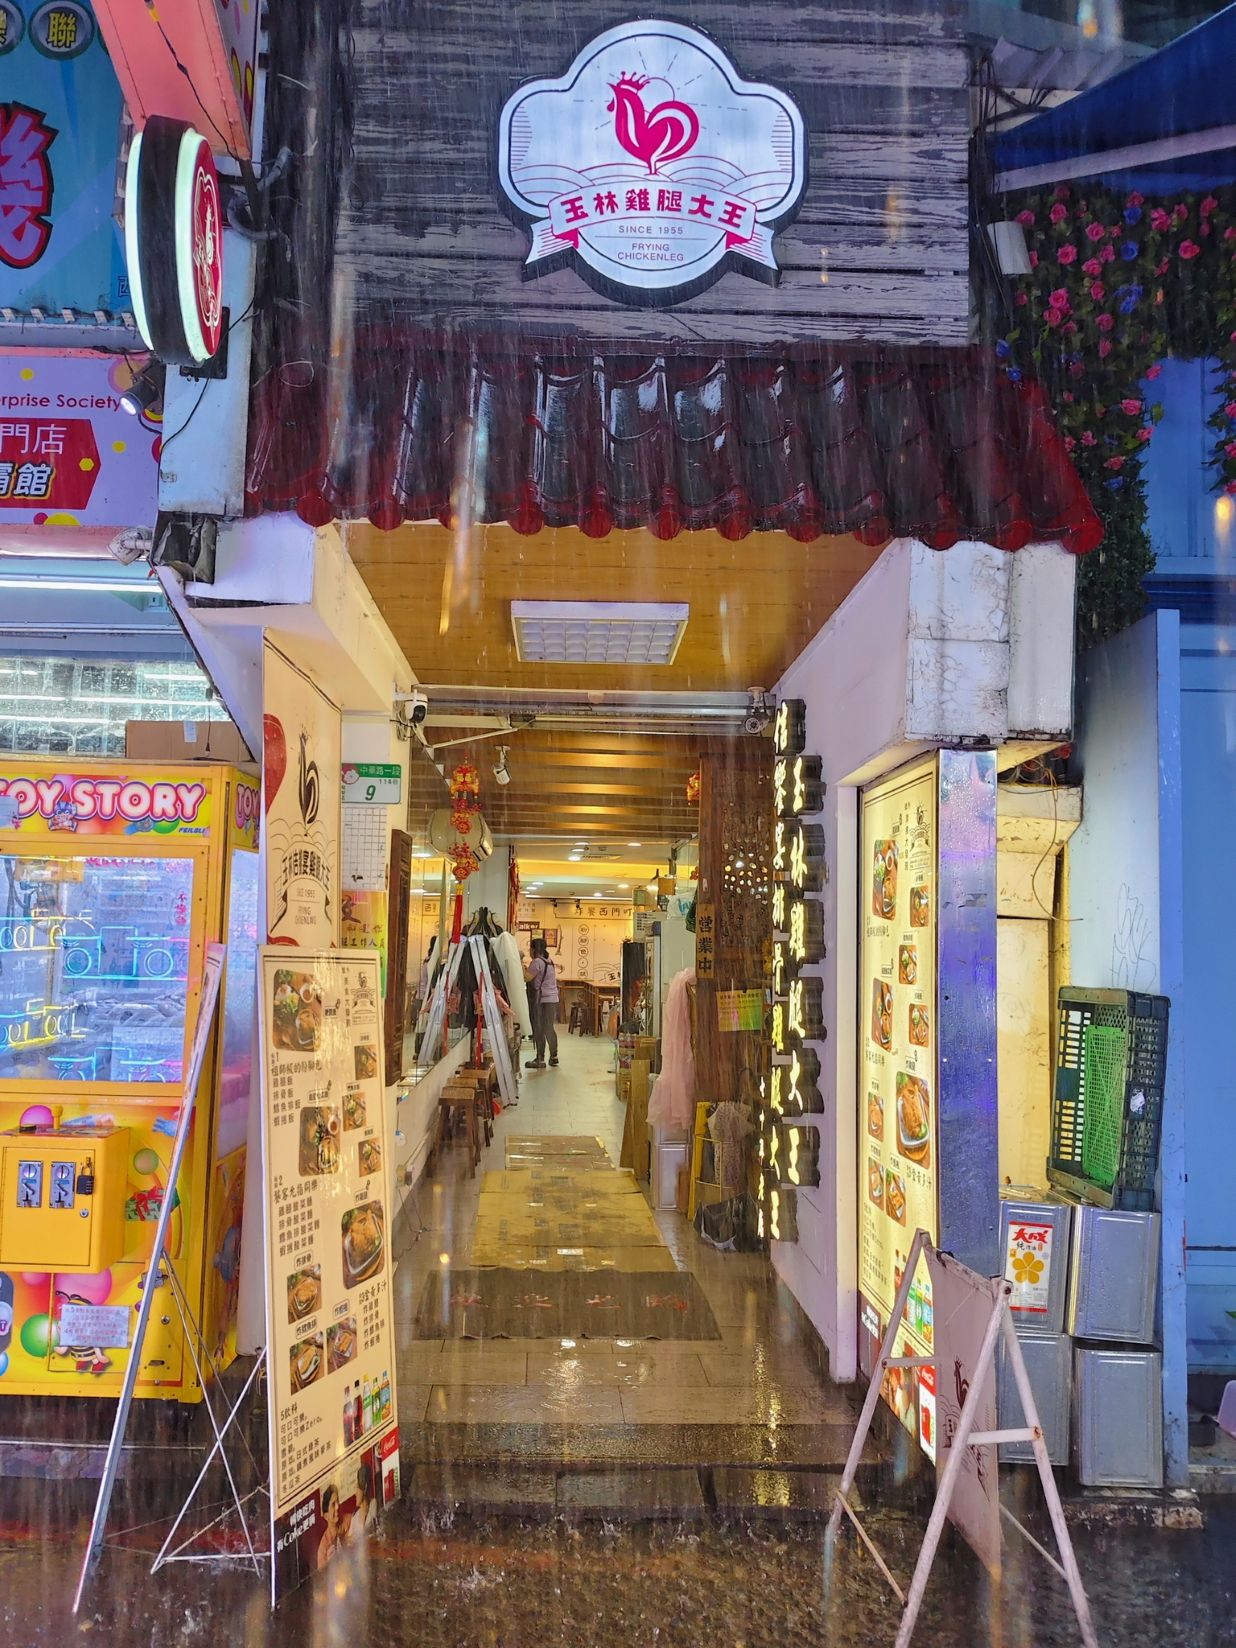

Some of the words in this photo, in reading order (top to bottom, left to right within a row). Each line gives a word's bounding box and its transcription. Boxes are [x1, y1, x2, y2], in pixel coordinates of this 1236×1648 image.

[47, 12, 77, 47] 聯
[560, 188, 747, 229] 玉林雞腿大王
[618, 225, 652, 234] SINCE
[658, 226, 684, 235] 1955
[631, 242, 670, 251] FRYING
[617, 251, 684, 262] CHICKENLEG
[56, 394, 122, 412] Society
[365, 784, 377, 801] 9
[70, 780, 206, 823] STORY
